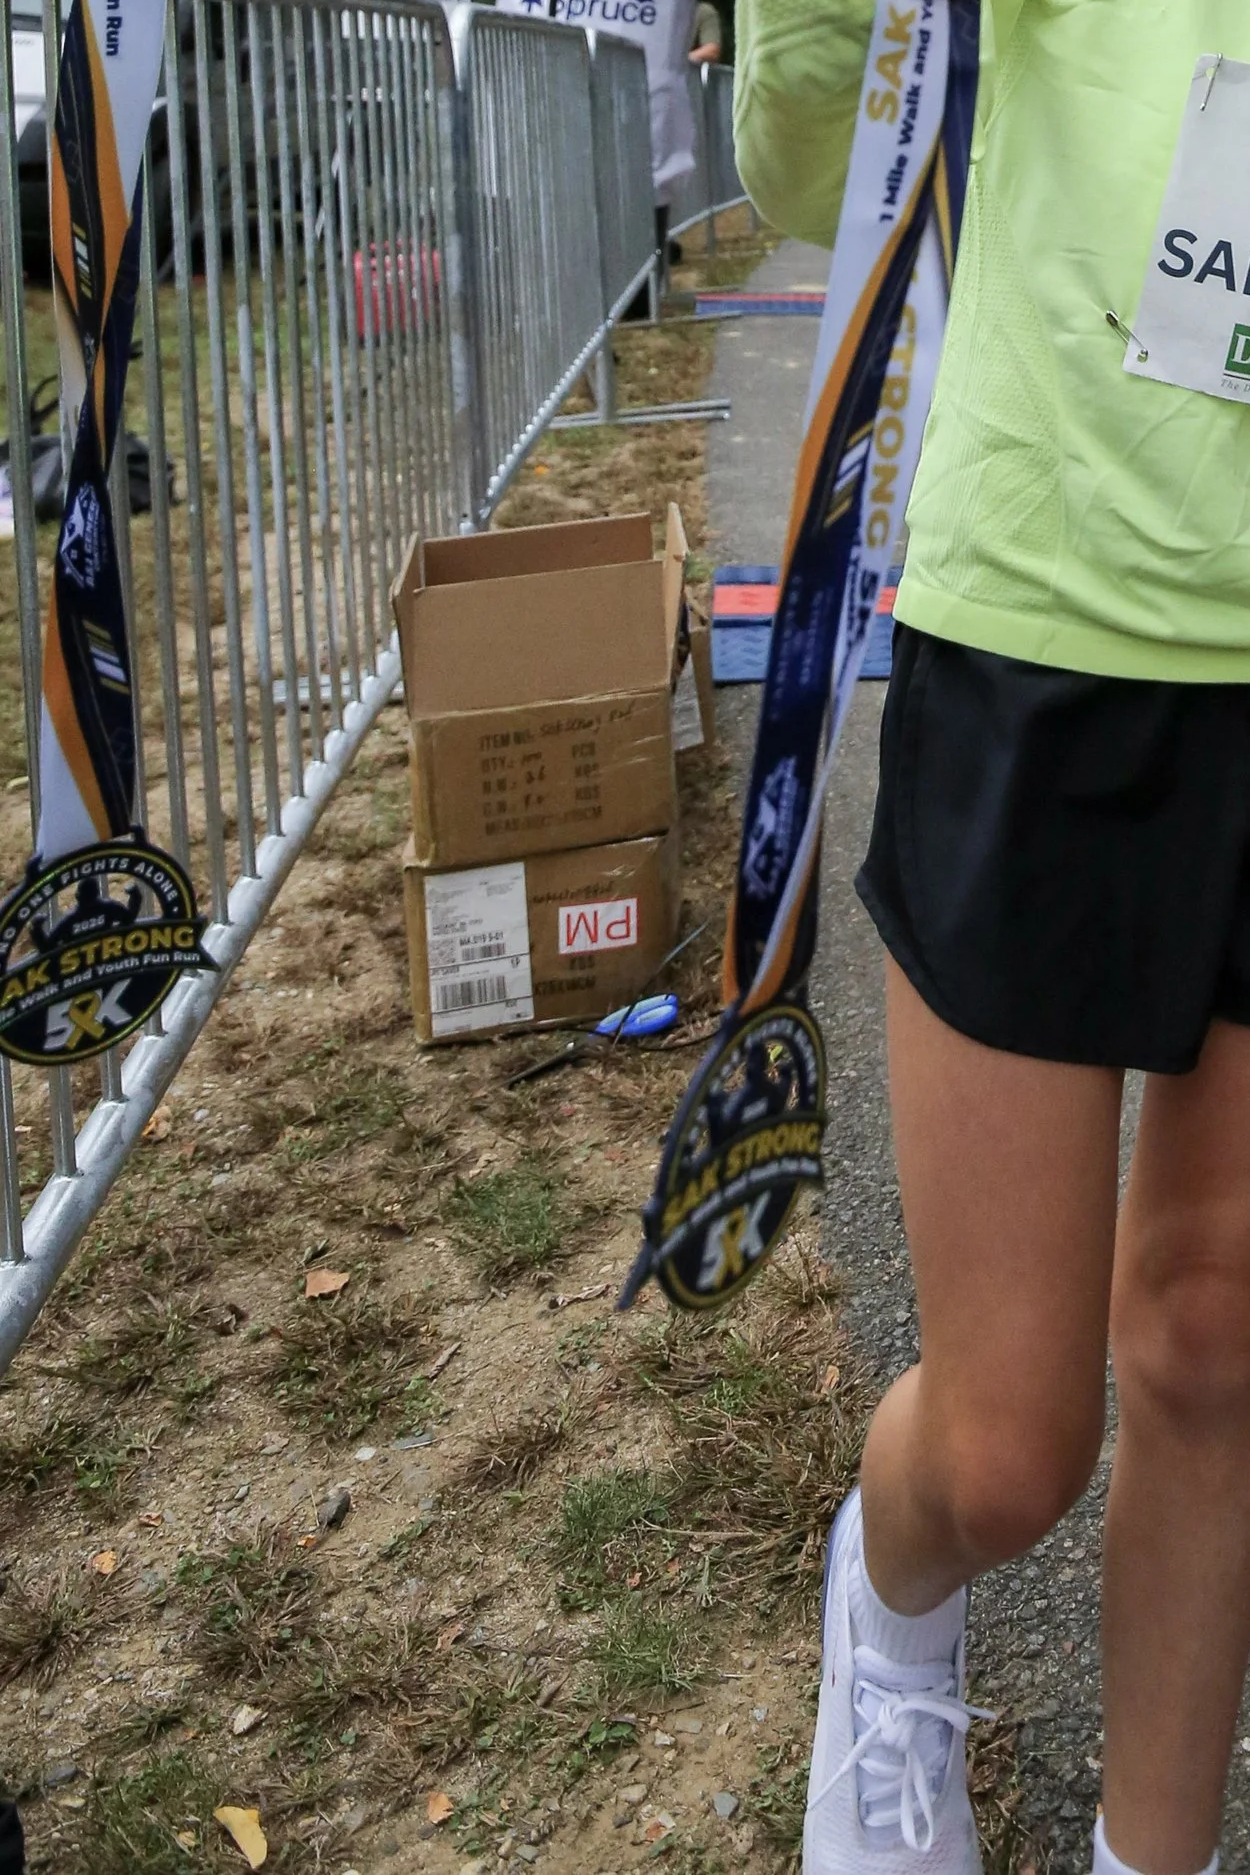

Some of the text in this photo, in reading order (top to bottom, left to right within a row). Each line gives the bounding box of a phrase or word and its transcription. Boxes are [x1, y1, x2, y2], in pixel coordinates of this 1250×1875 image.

[106, 15, 123, 56] Run
[866, 3, 917, 125] SAK
[914, 29, 932, 75] and
[897, 84, 921, 146] Walk
[883, 154, 908, 206] Mile
[879, 212, 894, 222] 1
[1220, 379, 1237, 390] The
[18, 886, 55, 919] ONE
[61, 857, 130, 885] FIGHTS
[134, 861, 178, 902] ALONE
[566, 906, 631, 947] PM
[0, 927, 194, 1008] AK STRONG
[20, 951, 200, 1009] Walk and Youth Fun Run
[43, 978, 133, 1050] 5K
[660, 1158, 721, 1237] SAK
[726, 1122, 820, 1178] STRONG
